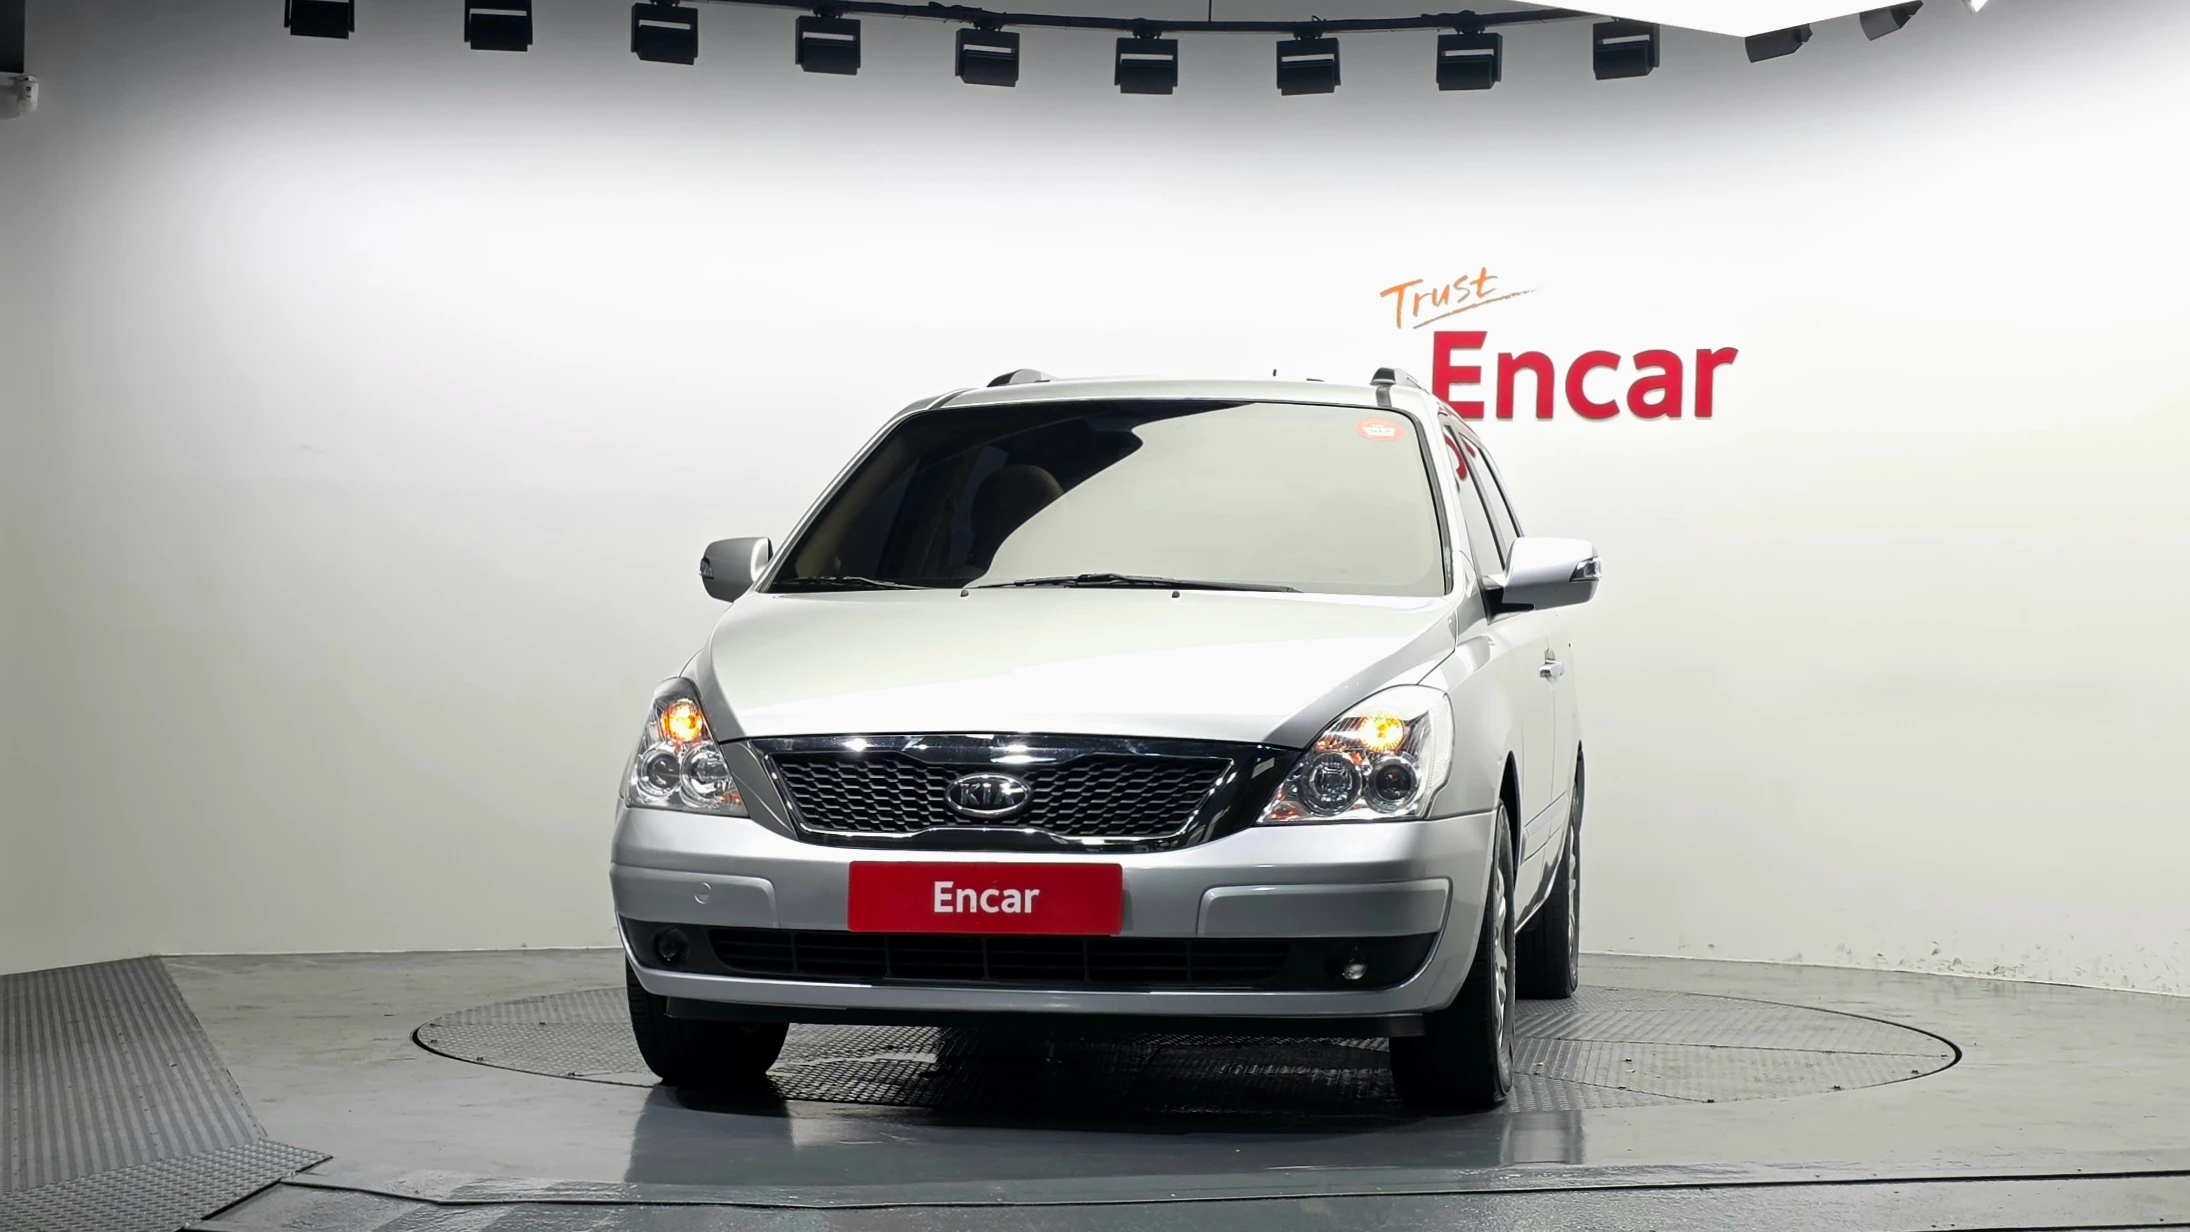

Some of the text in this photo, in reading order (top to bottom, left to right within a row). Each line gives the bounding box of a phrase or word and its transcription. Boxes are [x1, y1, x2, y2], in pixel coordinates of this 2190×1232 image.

[1380, 267, 1498, 329] Trust
[1432, 331, 1739, 419] Encar
[959, 782, 1016, 806] KIA
[933, 881, 1040, 914] Encar
